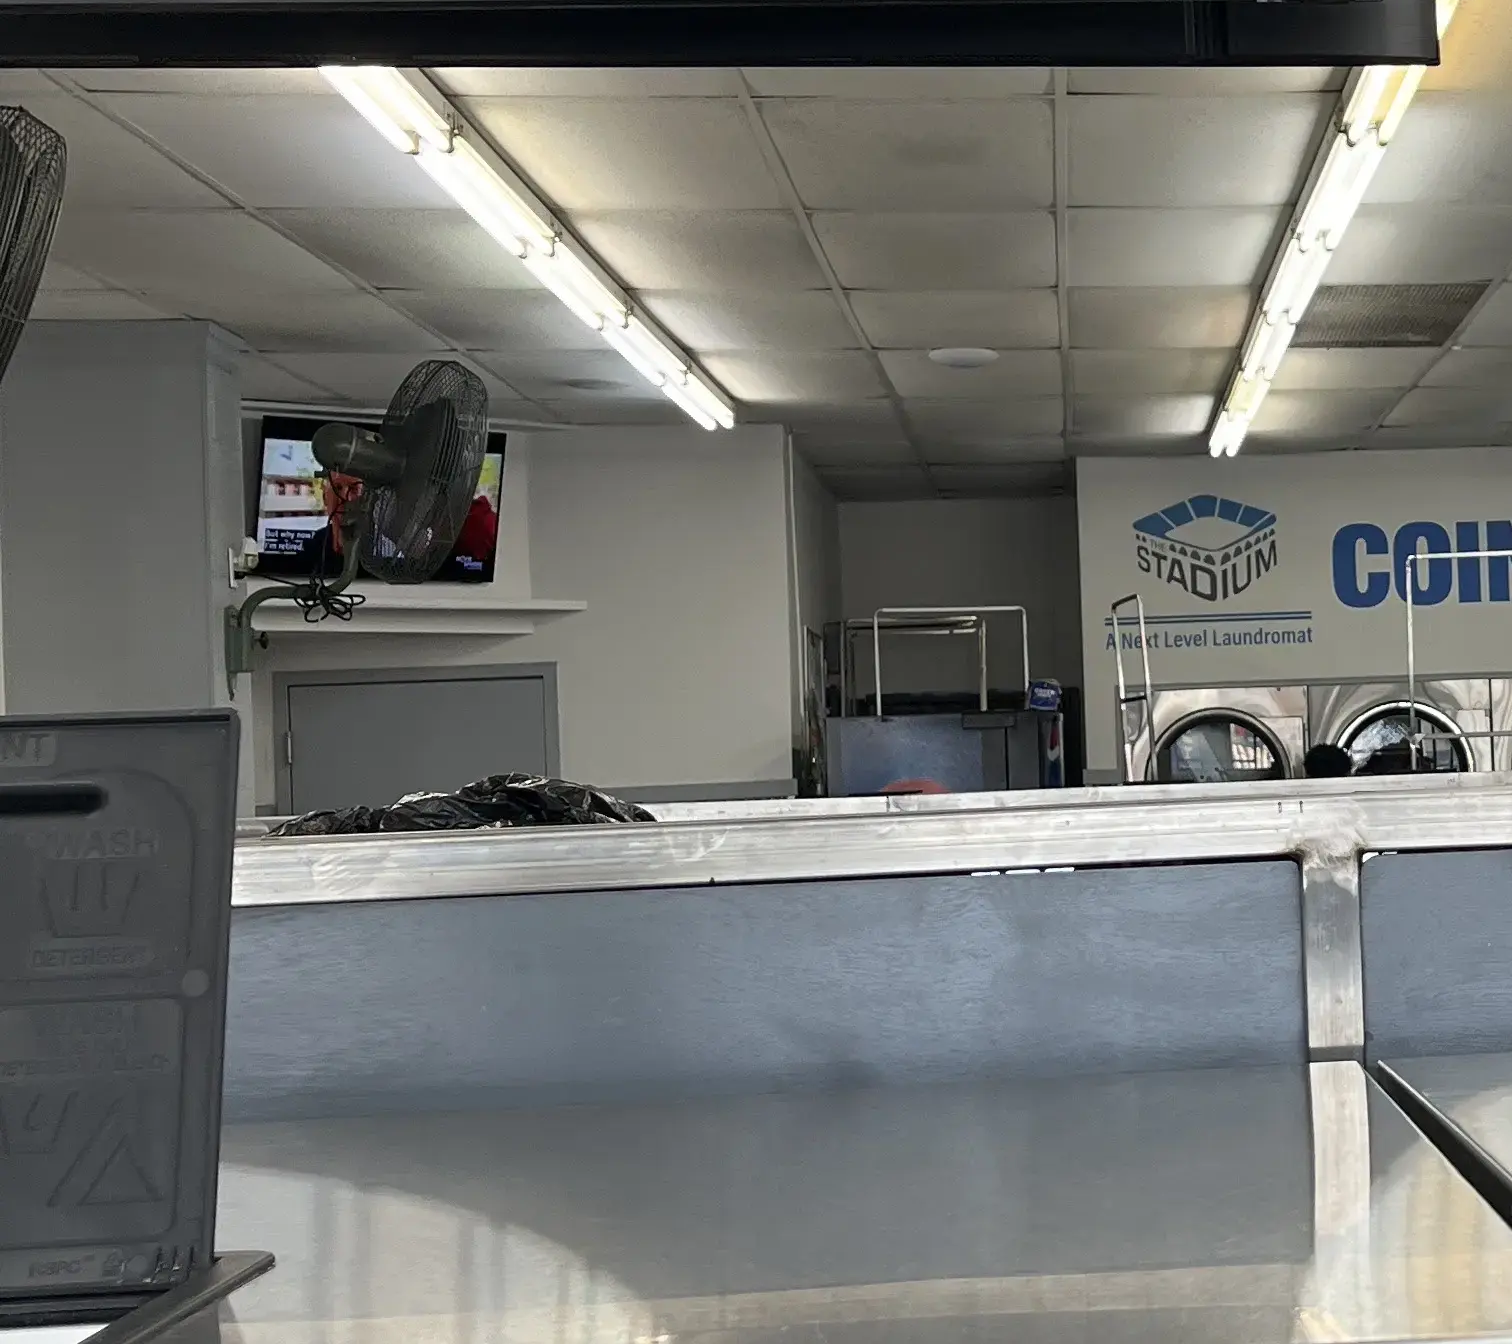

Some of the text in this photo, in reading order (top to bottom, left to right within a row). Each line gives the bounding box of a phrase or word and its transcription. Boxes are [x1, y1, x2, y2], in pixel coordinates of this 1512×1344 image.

[1150, 538, 1166, 553] THE
[1136, 539, 1278, 602] STADIUM
[1121, 631, 1159, 650] Next
[1165, 629, 1208, 648] Level
[1213, 626, 1313, 647] Laundromat
